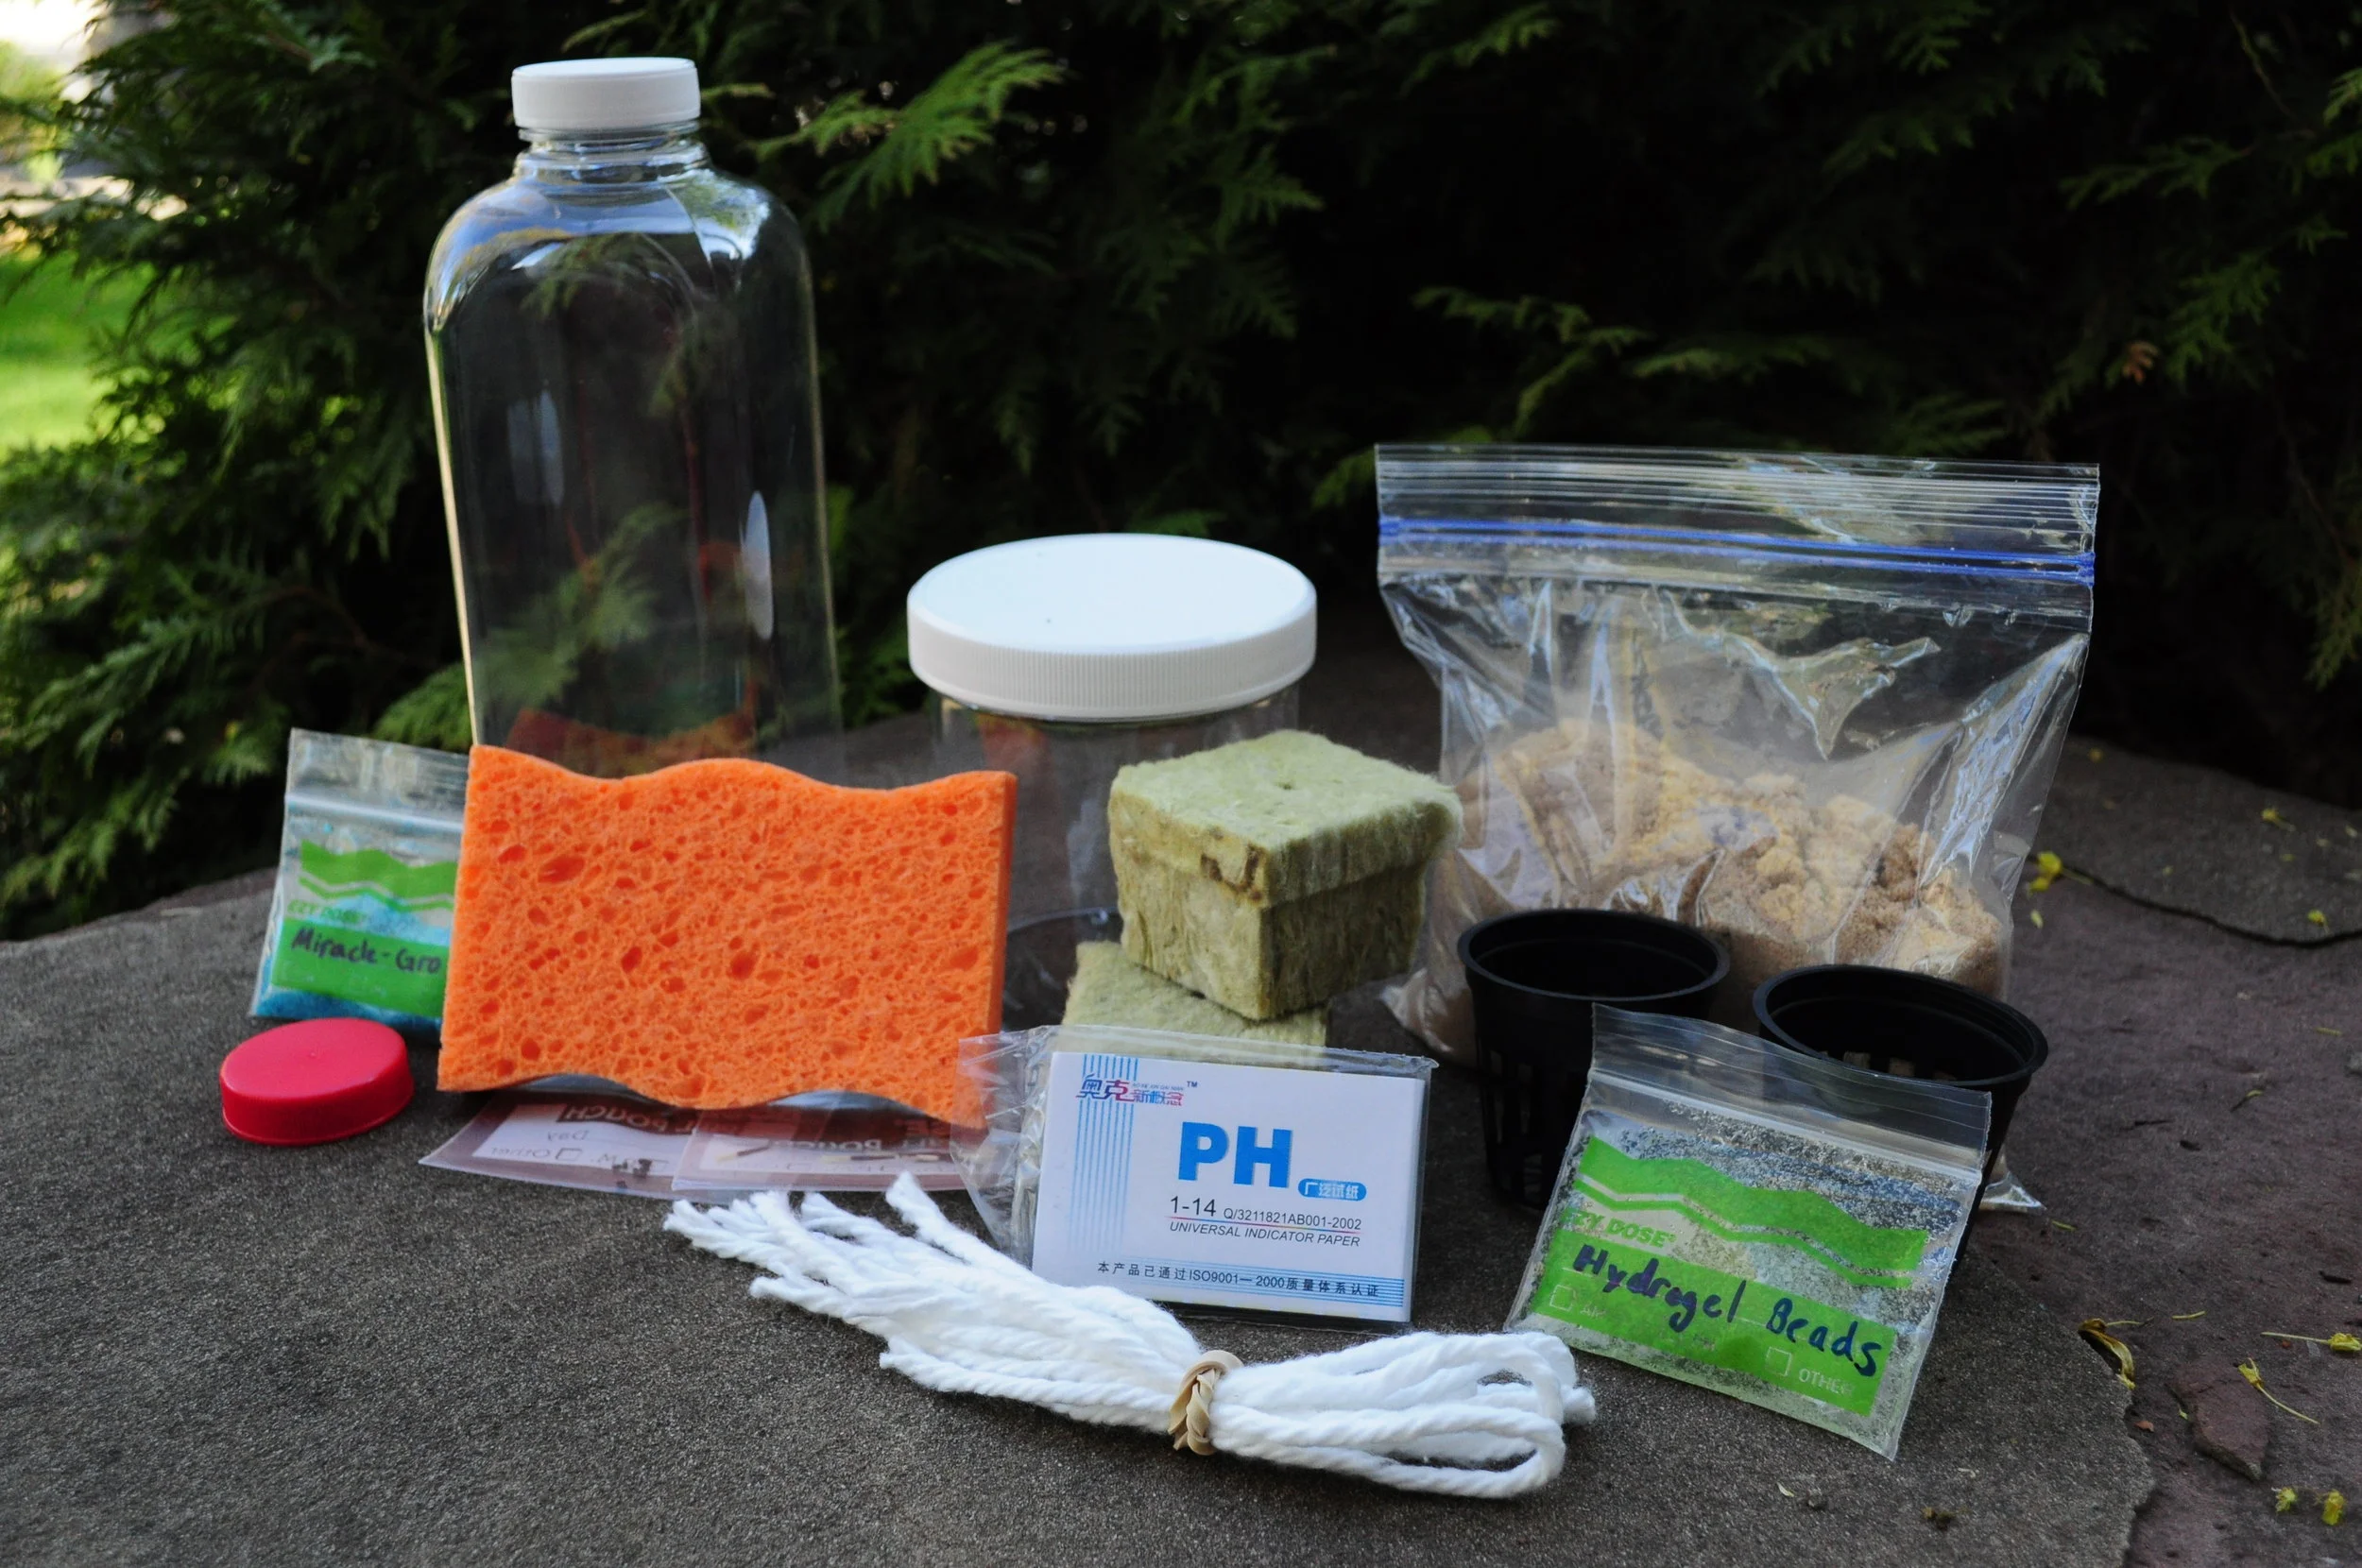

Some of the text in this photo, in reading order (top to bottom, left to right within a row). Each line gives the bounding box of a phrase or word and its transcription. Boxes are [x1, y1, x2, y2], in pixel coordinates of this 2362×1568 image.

[1179, 1121, 1293, 1188] PH
[1170, 1195, 1361, 1231] 1-14 Q/3211821AB001-2002
[1170, 1221, 1361, 1248] UNIVERSAL INDICATOR PAPER
[1572, 1243, 1883, 1376] Hydrogel Beads
